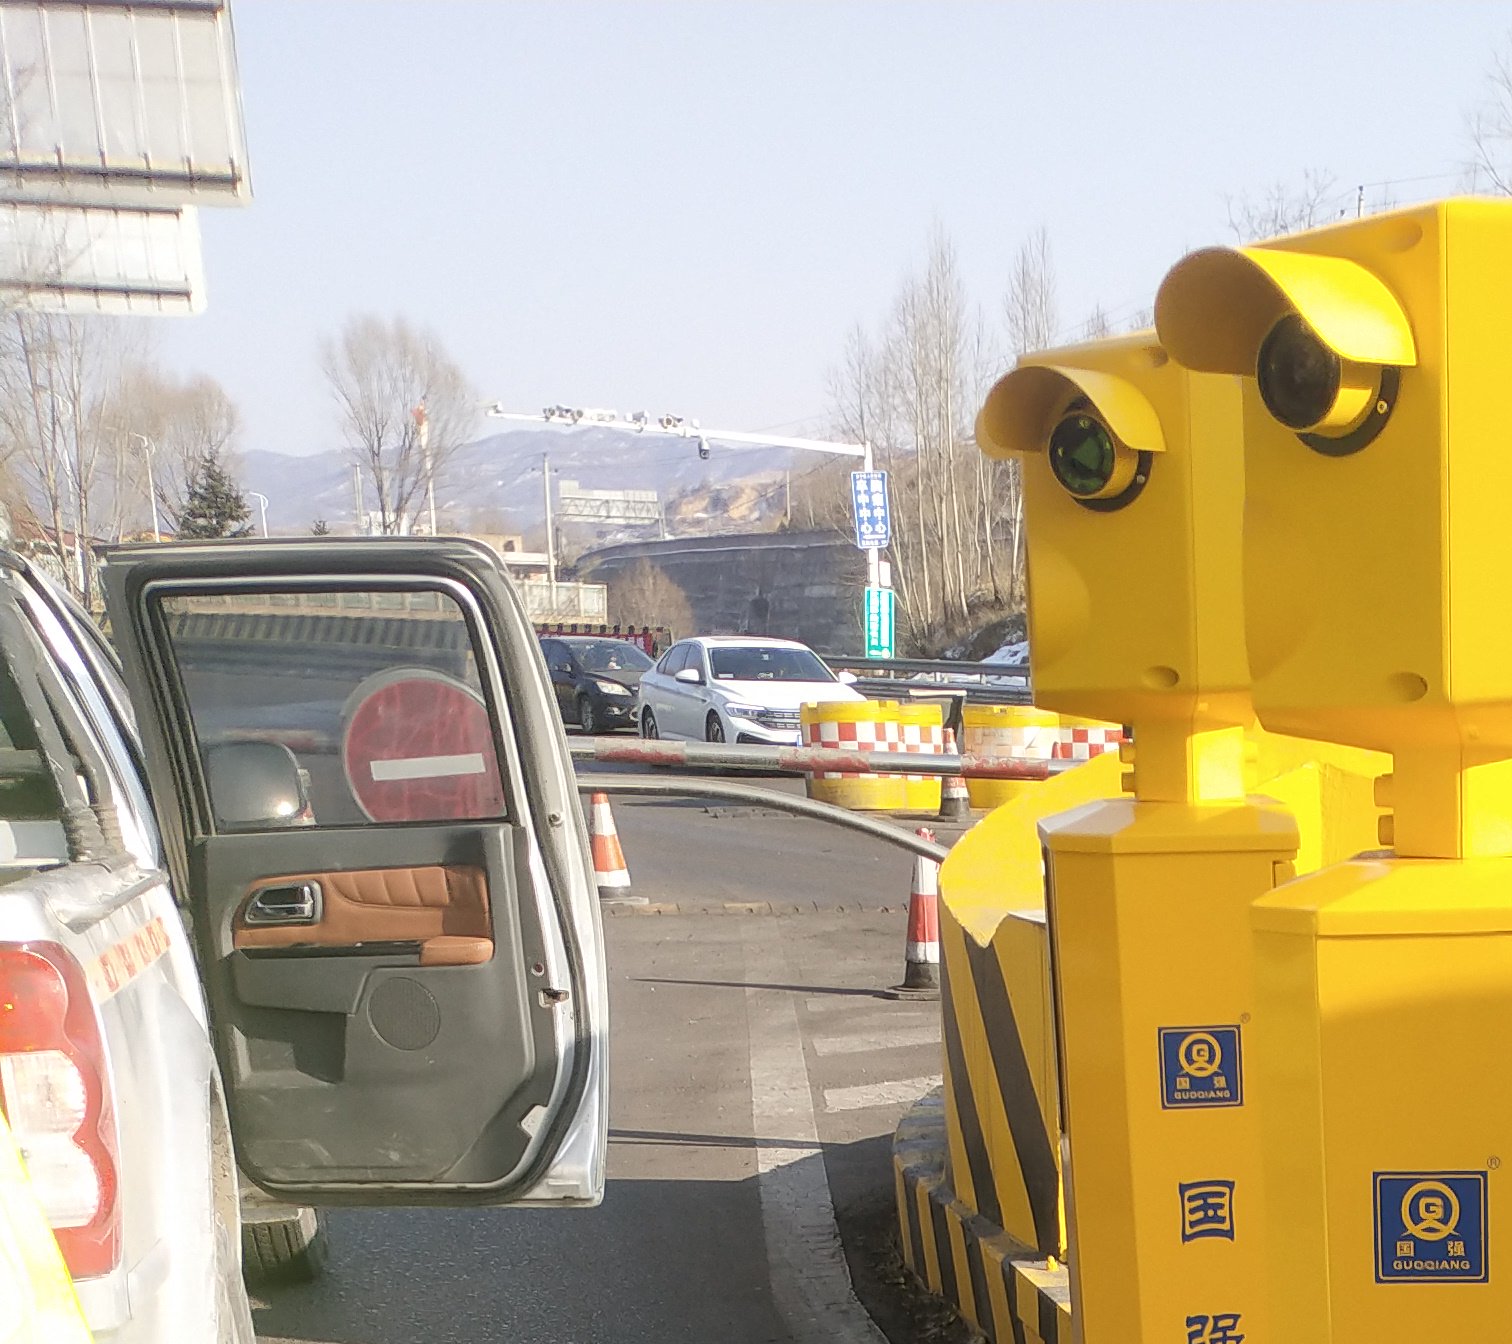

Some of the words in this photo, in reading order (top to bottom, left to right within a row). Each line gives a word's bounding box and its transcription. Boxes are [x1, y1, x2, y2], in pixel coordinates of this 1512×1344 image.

[1174, 1089, 1230, 1100] GUOQIANG
[1396, 1240, 1466, 1257] 国强
[1393, 1260, 1471, 1270] GUOQIANG
